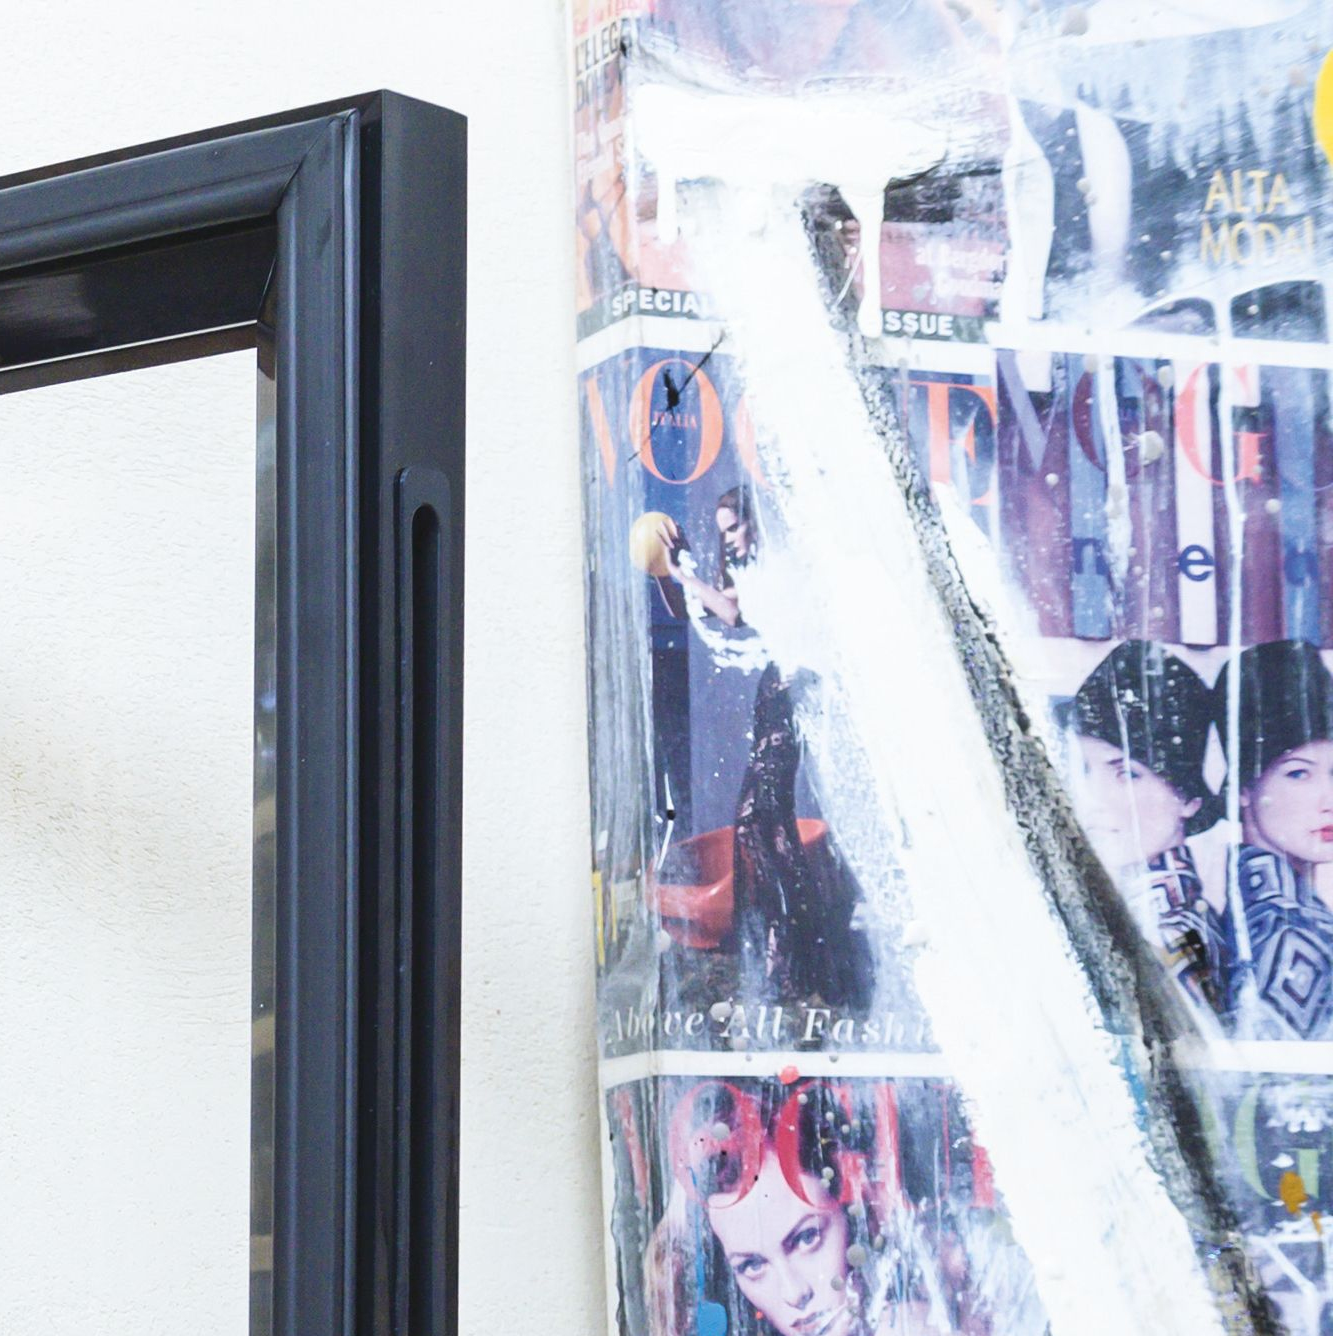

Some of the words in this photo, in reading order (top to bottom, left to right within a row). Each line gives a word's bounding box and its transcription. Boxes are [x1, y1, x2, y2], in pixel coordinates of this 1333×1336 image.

[1204, 168, 1289, 214] ALTA
[612, 288, 716, 317] SPECIA
[874, 308, 954, 337] SSUE
